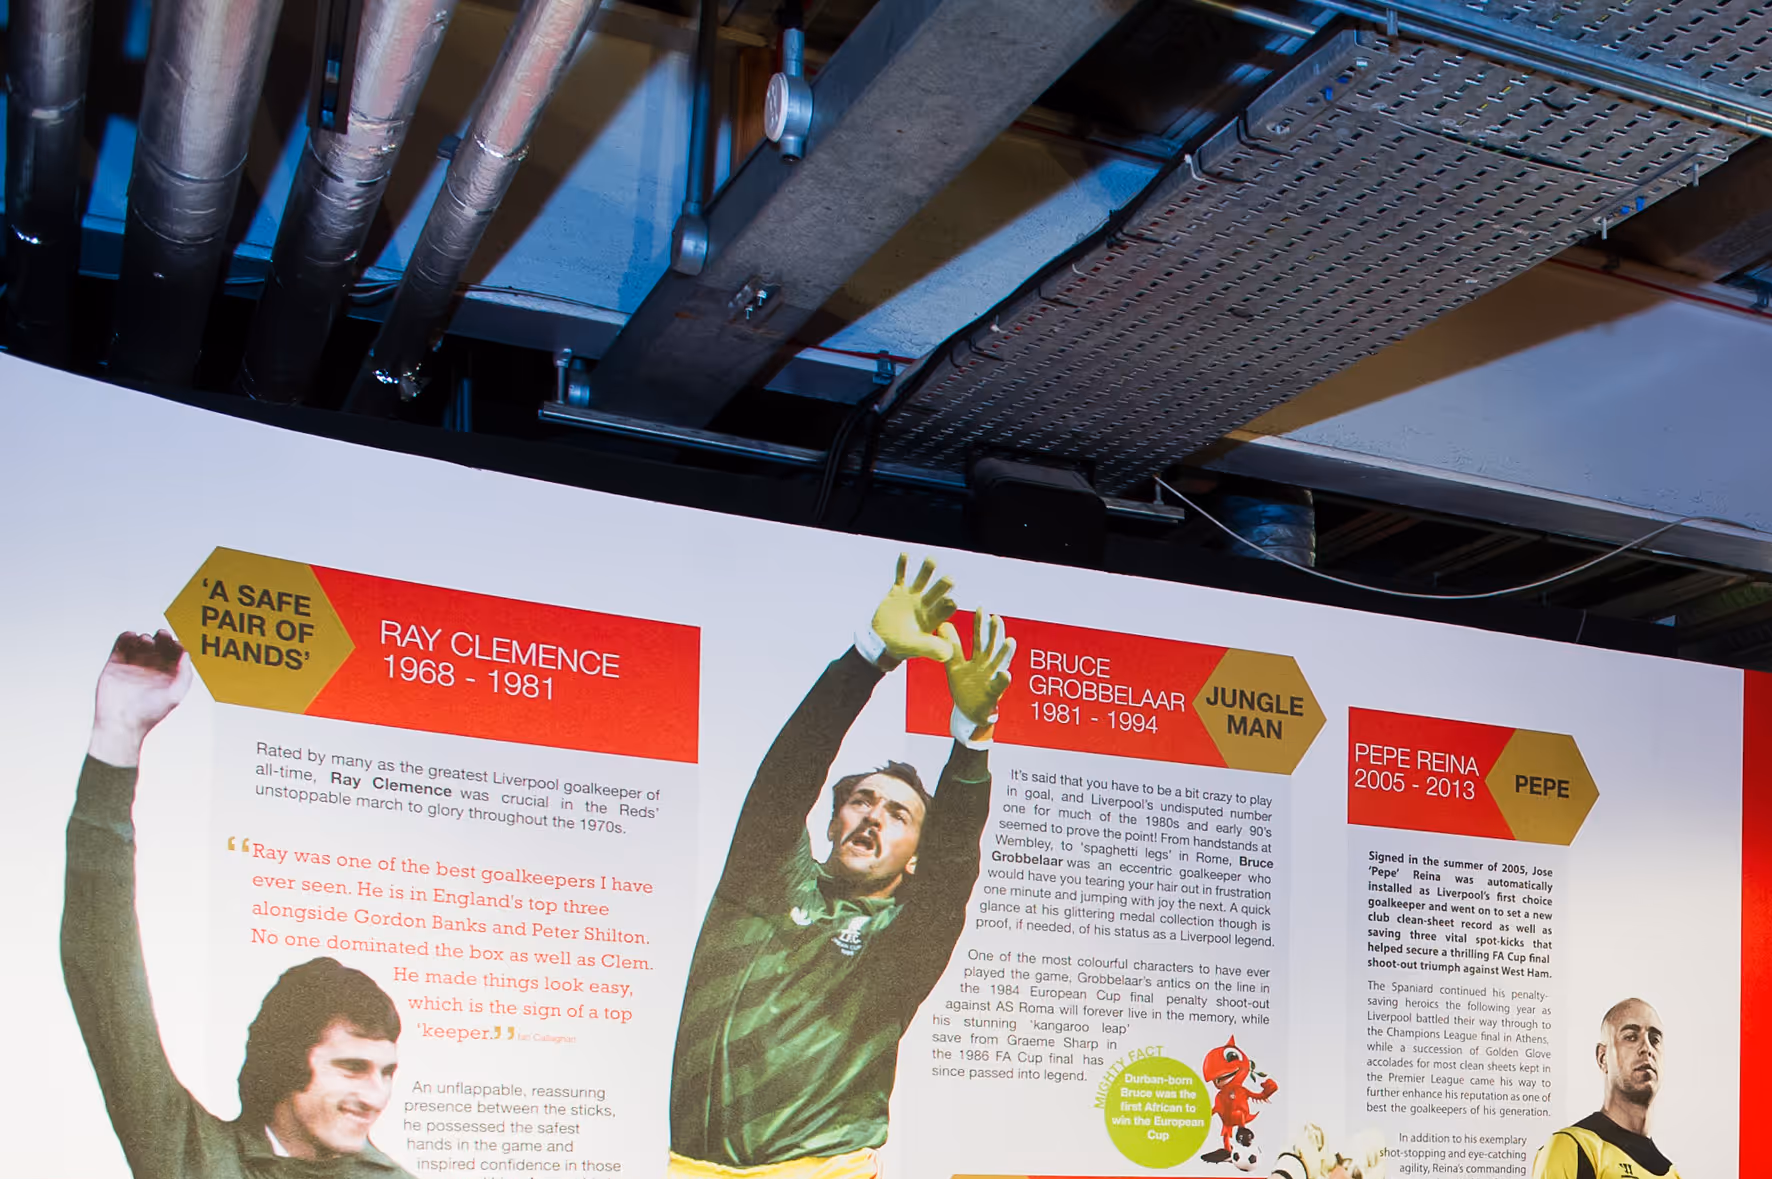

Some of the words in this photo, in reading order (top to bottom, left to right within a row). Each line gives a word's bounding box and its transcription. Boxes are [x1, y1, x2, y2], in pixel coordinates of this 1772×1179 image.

[237, 585, 311, 617] SAFE
[202, 605, 266, 637] PAIR
[276, 620, 314, 643] OF
[381, 620, 442, 651] RAY
[451, 632, 620, 678] CLEMENCE
[1031, 649, 1110, 678] BRUCE
[384, 654, 454, 686] 1968
[488, 670, 552, 700] 1981
[1030, 675, 1184, 712] GROBBELAAR
[1206, 686, 1304, 716] JUNGLE
[1031, 702, 1079, 725] 1981
[1108, 711, 1158, 733] 1994
[1228, 714, 1282, 739] MAN
[257, 742, 302, 760] Rated
[308, 749, 326, 766] by
[332, 755, 372, 771] many
[378, 761, 395, 771] as
[400, 761, 424, 775] the
[428, 767, 488, 782] greatest
[493, 772, 559, 790] Liverpool
[564, 783, 642, 800] goalkeeper
[647, 790, 660, 800] of
[1356, 743, 1410, 768] PEPE
[1417, 750, 1479, 776] REINA
[256, 763, 316, 783] all-time,
[331, 772, 361, 789] Ray
[373, 777, 452, 797] Clemence
[460, 790, 489, 801] was
[502, 792, 548, 807] crucial
[561, 795, 574, 811] in
[585, 801, 607, 814] the
[1355, 768, 1405, 792] 2005
[1426, 776, 1474, 800] 2013
[1516, 775, 1569, 798] PEPE
[1369, 851, 1404, 864] Signed
[1409, 854, 1418, 864] in
[1423, 856, 1439, 866] the
[1444, 860, 1483, 870] summer
[1488, 862, 1498, 871] of
[1502, 864, 1528, 876] 2005,
[1532, 867, 1553, 877] Jose
[252, 901, 348, 922] alongside
[354, 909, 426, 928] Gordon
[432, 915, 487, 932] Banks
[492, 922, 527, 936] and
[532, 923, 580, 939] Peter
[584, 927, 649, 944] Shilton.
[932, 1065, 965, 1077] since
[969, 1068, 1013, 1080] passed
[1018, 1068, 1040, 1079] into
[1044, 1069, 1087, 1083] legend.
[1094, 1057, 1127, 1109] MIGHTY
[1128, 1045, 1164, 1062] FACT
[412, 1081, 432, 1093] An
[438, 1082, 526, 1098] unflappable,
[532, 1088, 605, 1102] reassuring
[1120, 1087, 1152, 1098] Bruce
[1153, 1087, 1177, 1101] was
[1179, 1089, 1196, 1099] the
[1120, 1101, 1142, 1111] first
[1143, 1100, 1182, 1112] African
[1185, 1104, 1196, 1112] to
[1112, 1115, 1132, 1125] win
[1133, 1115, 1154, 1127] the
[1154, 1115, 1204, 1128] European
[1147, 1129, 1169, 1142] Cup
